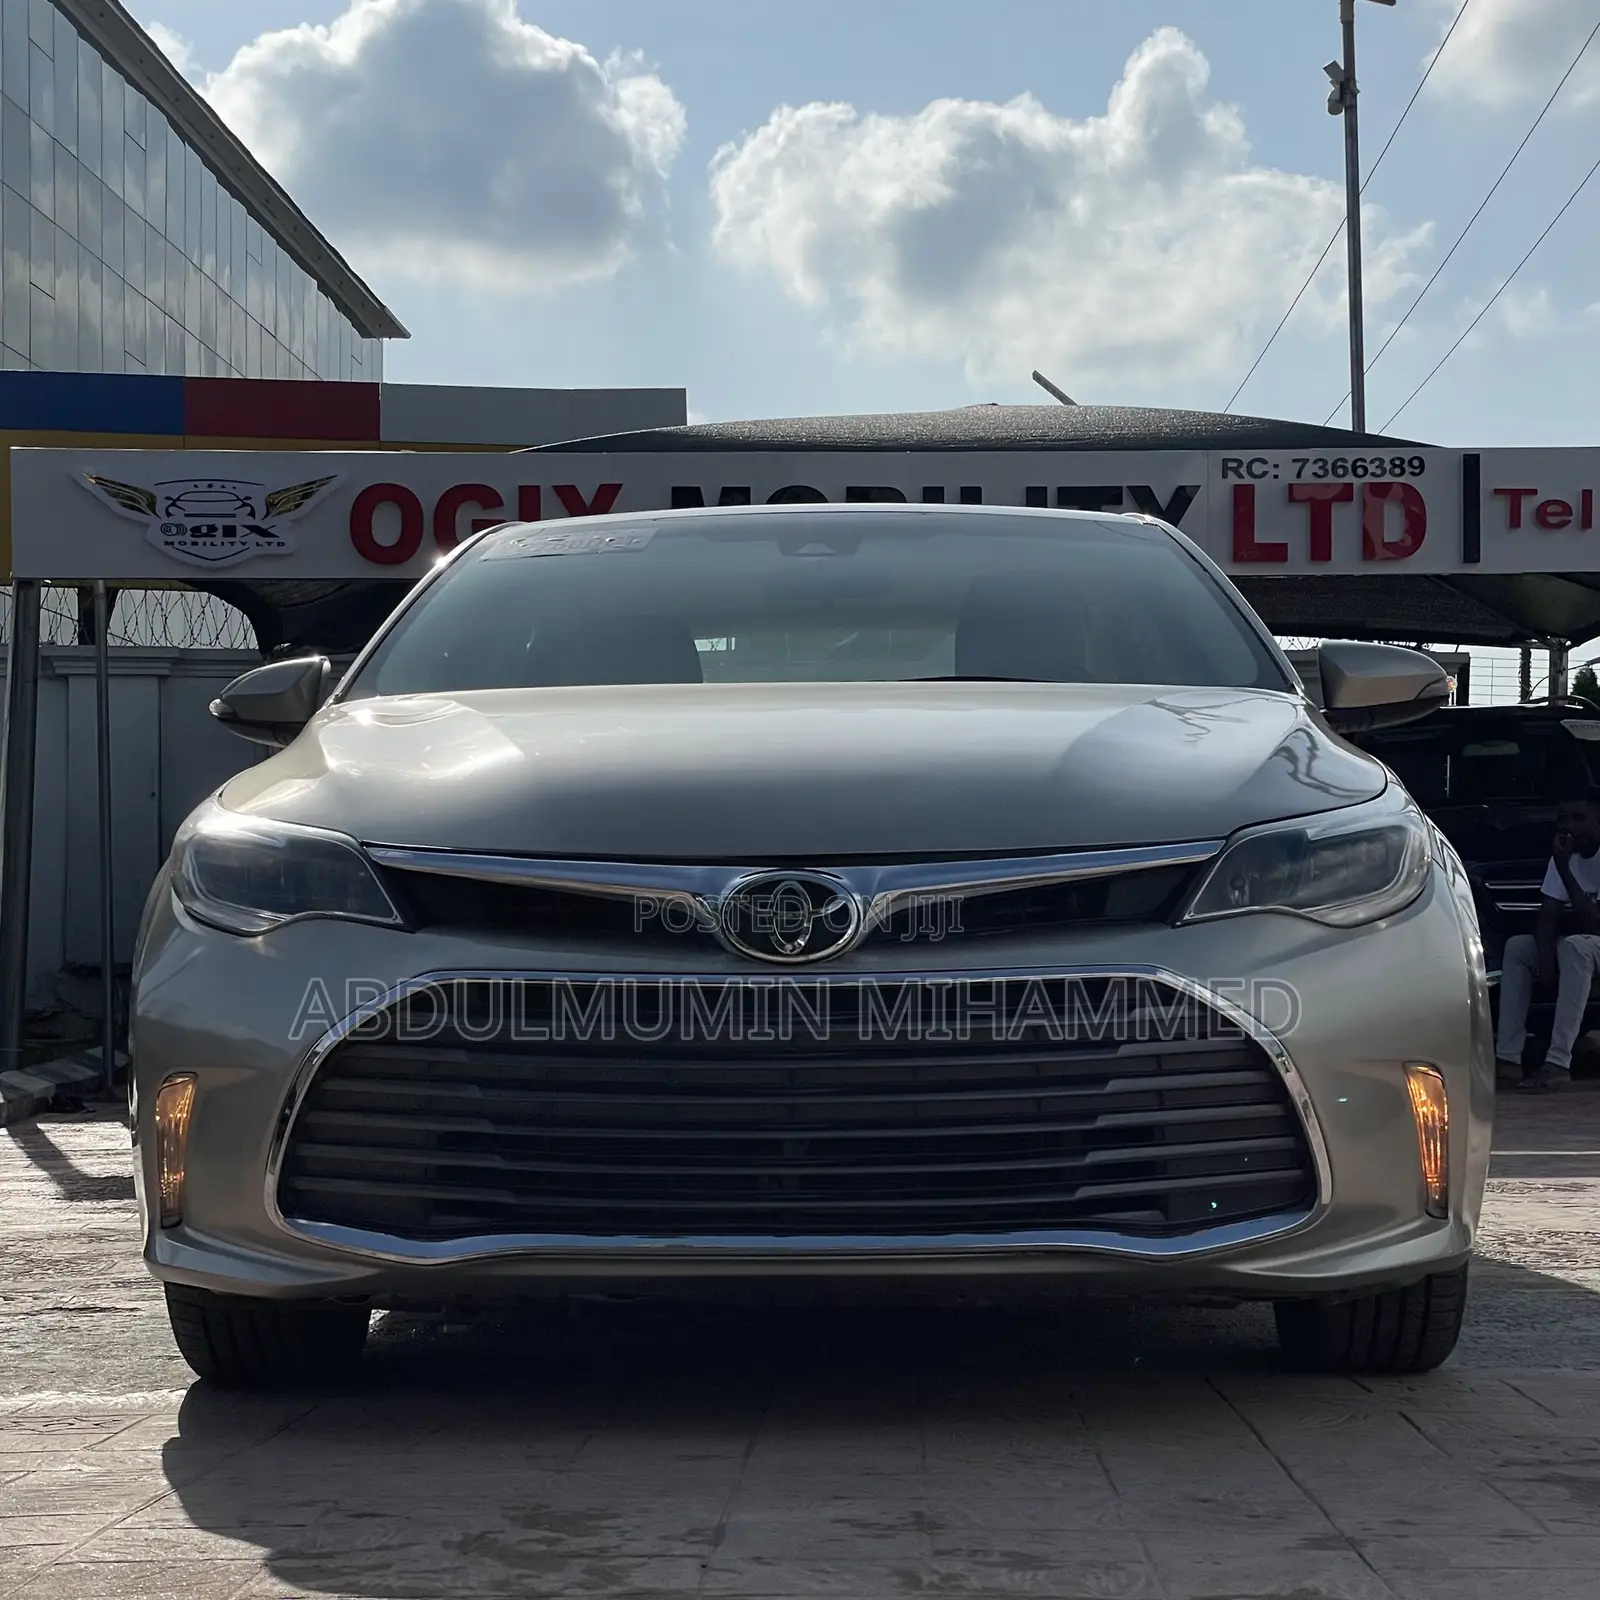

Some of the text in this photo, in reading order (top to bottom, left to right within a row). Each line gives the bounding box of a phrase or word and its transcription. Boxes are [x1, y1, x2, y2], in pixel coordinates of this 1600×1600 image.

[1221, 455, 1426, 479] RC: 7366389
[1232, 482, 1428, 563] LTD
[1493, 488, 1593, 530] Tel
[163, 540, 286, 548] MOBILITY LTD
